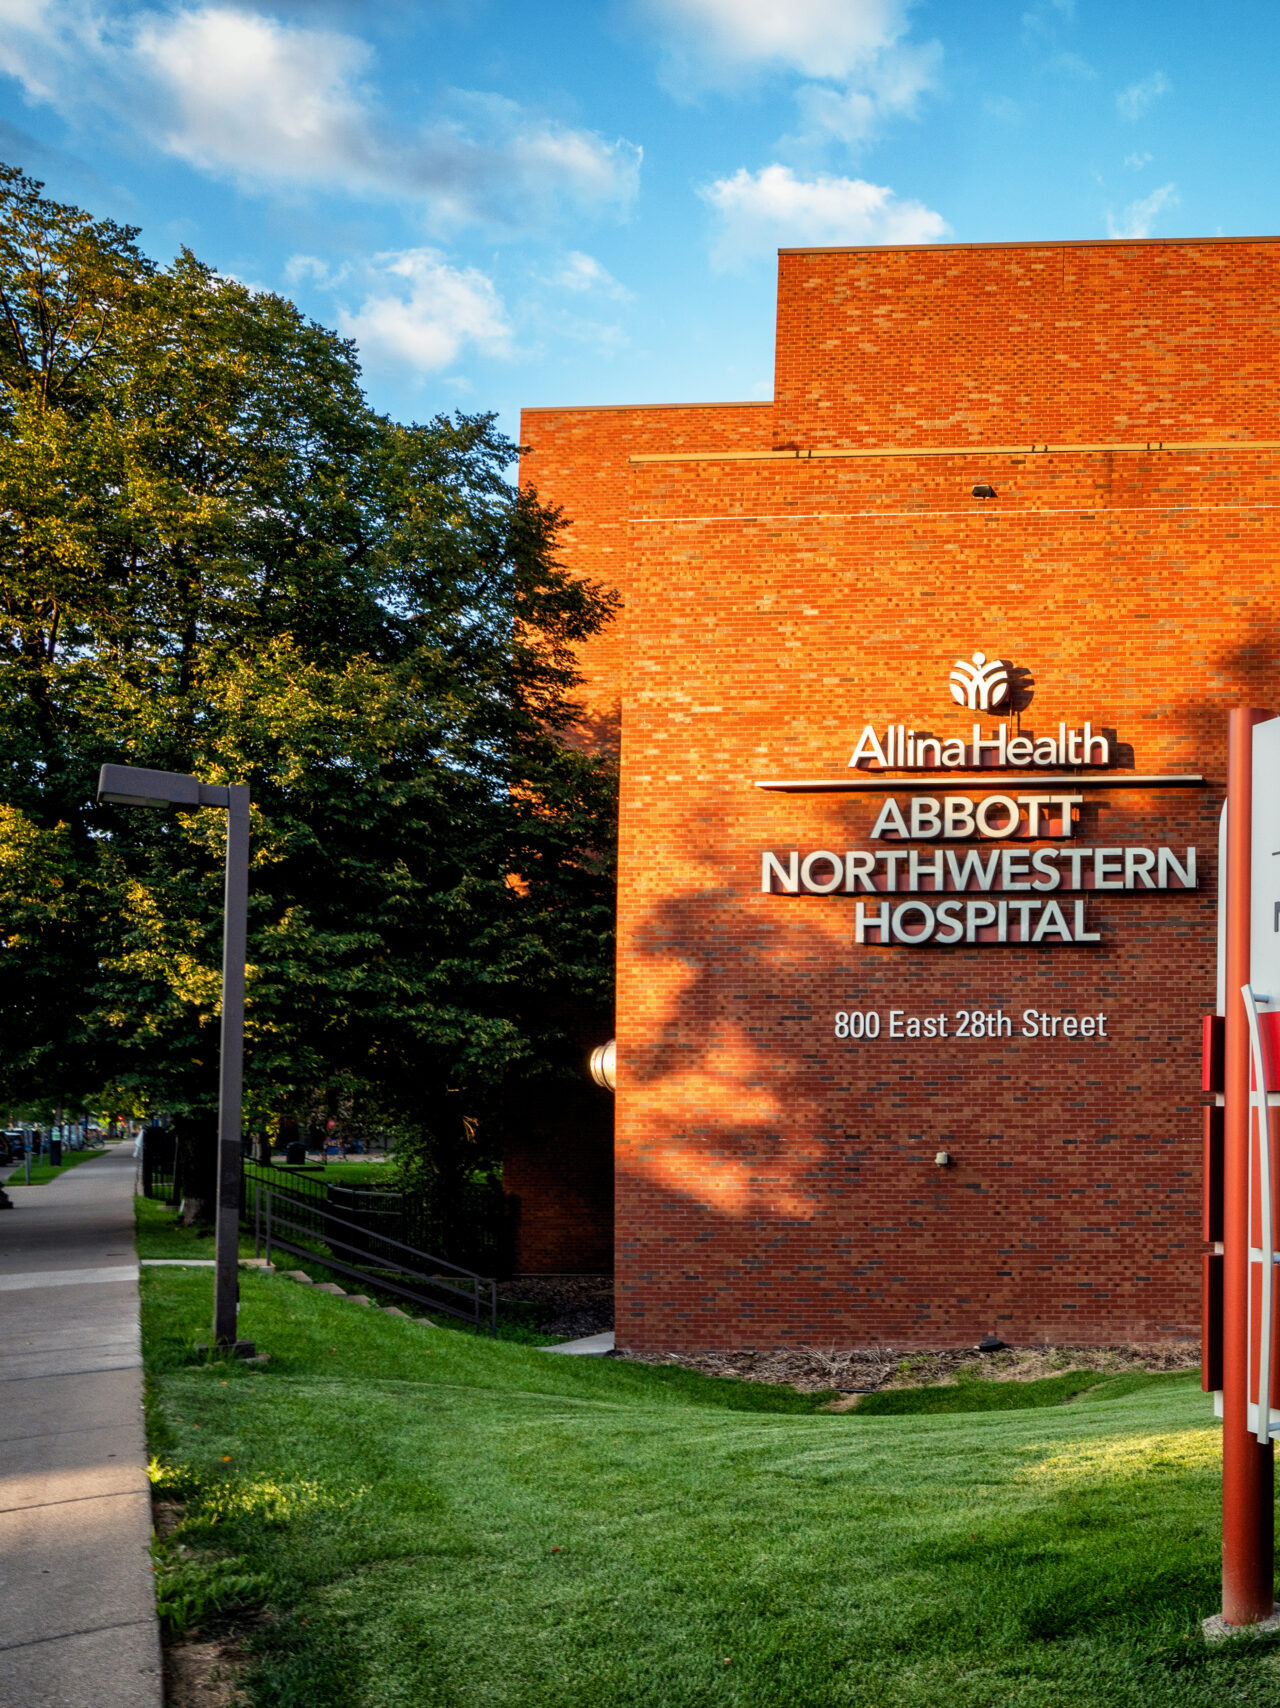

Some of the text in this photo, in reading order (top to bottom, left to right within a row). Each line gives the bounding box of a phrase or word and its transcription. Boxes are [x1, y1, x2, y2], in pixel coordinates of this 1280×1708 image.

[848, 721, 1110, 769] Allina Health
[869, 795, 1083, 840] ABBOTT
[761, 846, 1197, 893] NORTHWESTERN
[855, 899, 1101, 944] HOSPITAL
[834, 1008, 1107, 1039] 800 East 28th Street
